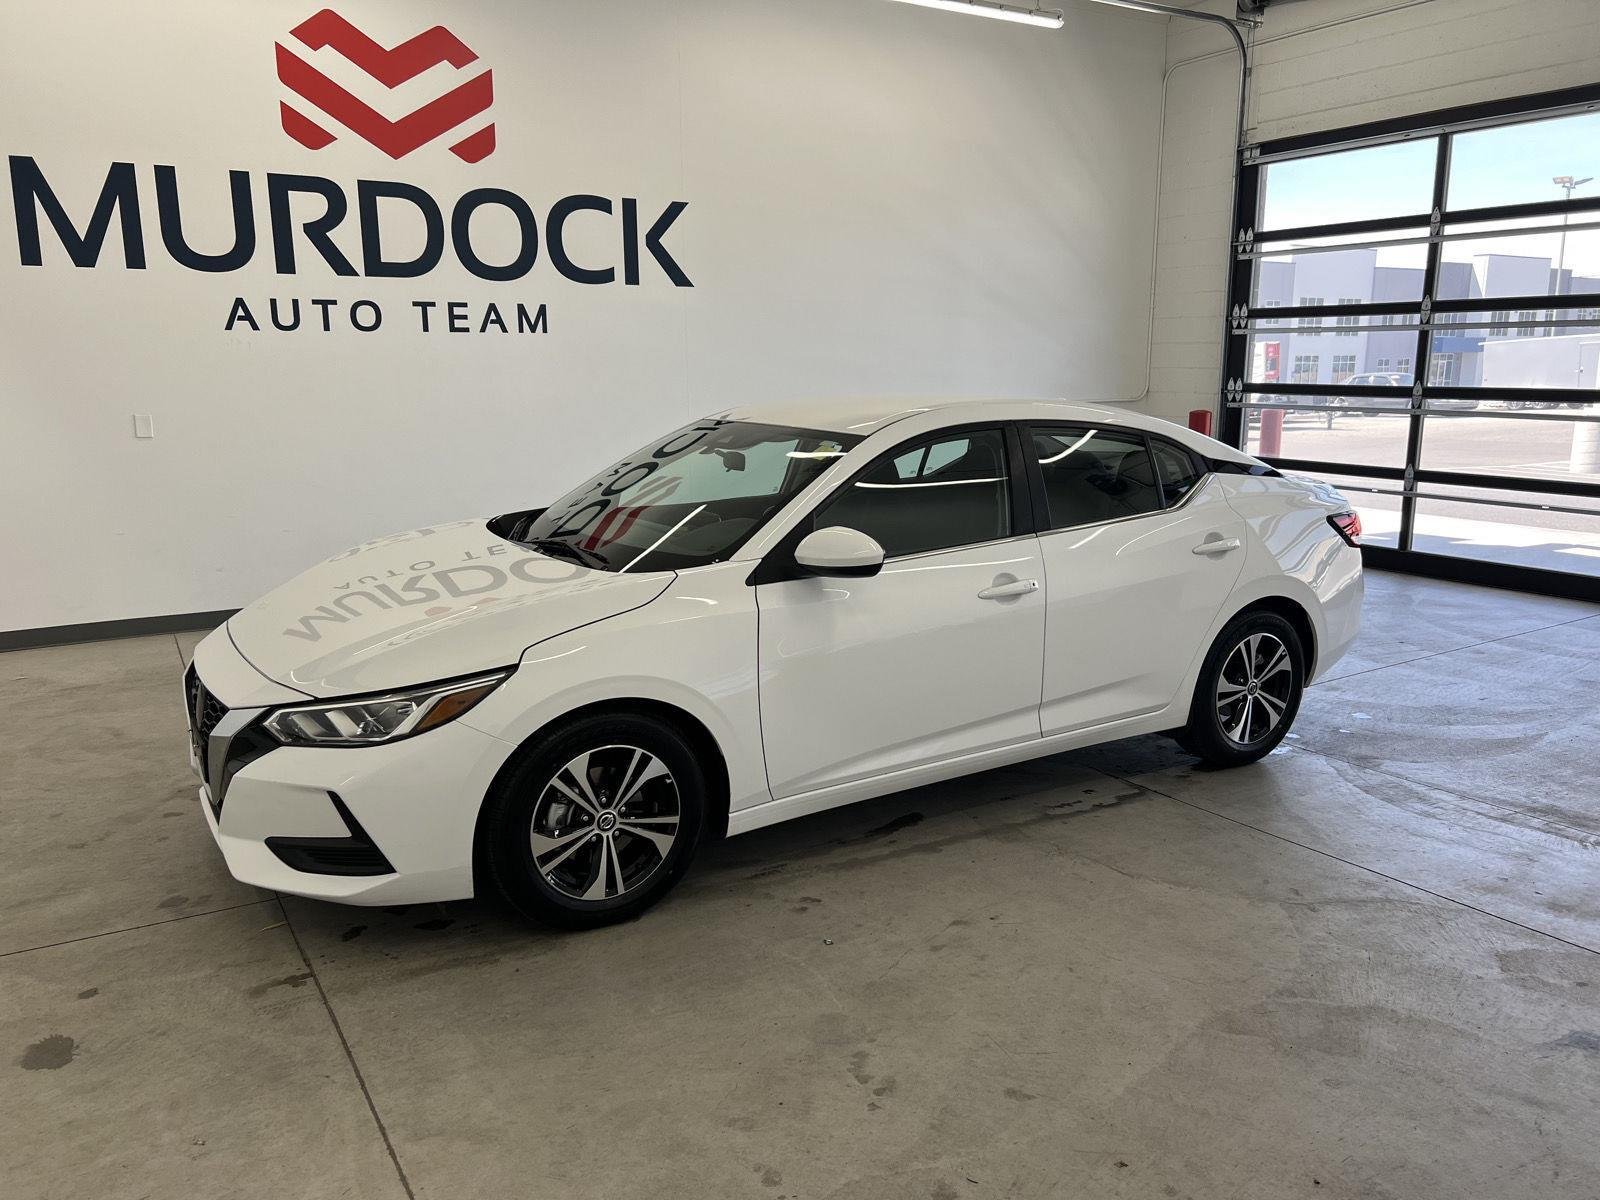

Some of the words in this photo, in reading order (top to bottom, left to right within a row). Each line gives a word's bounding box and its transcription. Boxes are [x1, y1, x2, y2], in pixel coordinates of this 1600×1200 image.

[9, 155, 694, 287] MURDOCK
[225, 298, 381, 332] AUTO
[412, 301, 548, 333] TEAM
